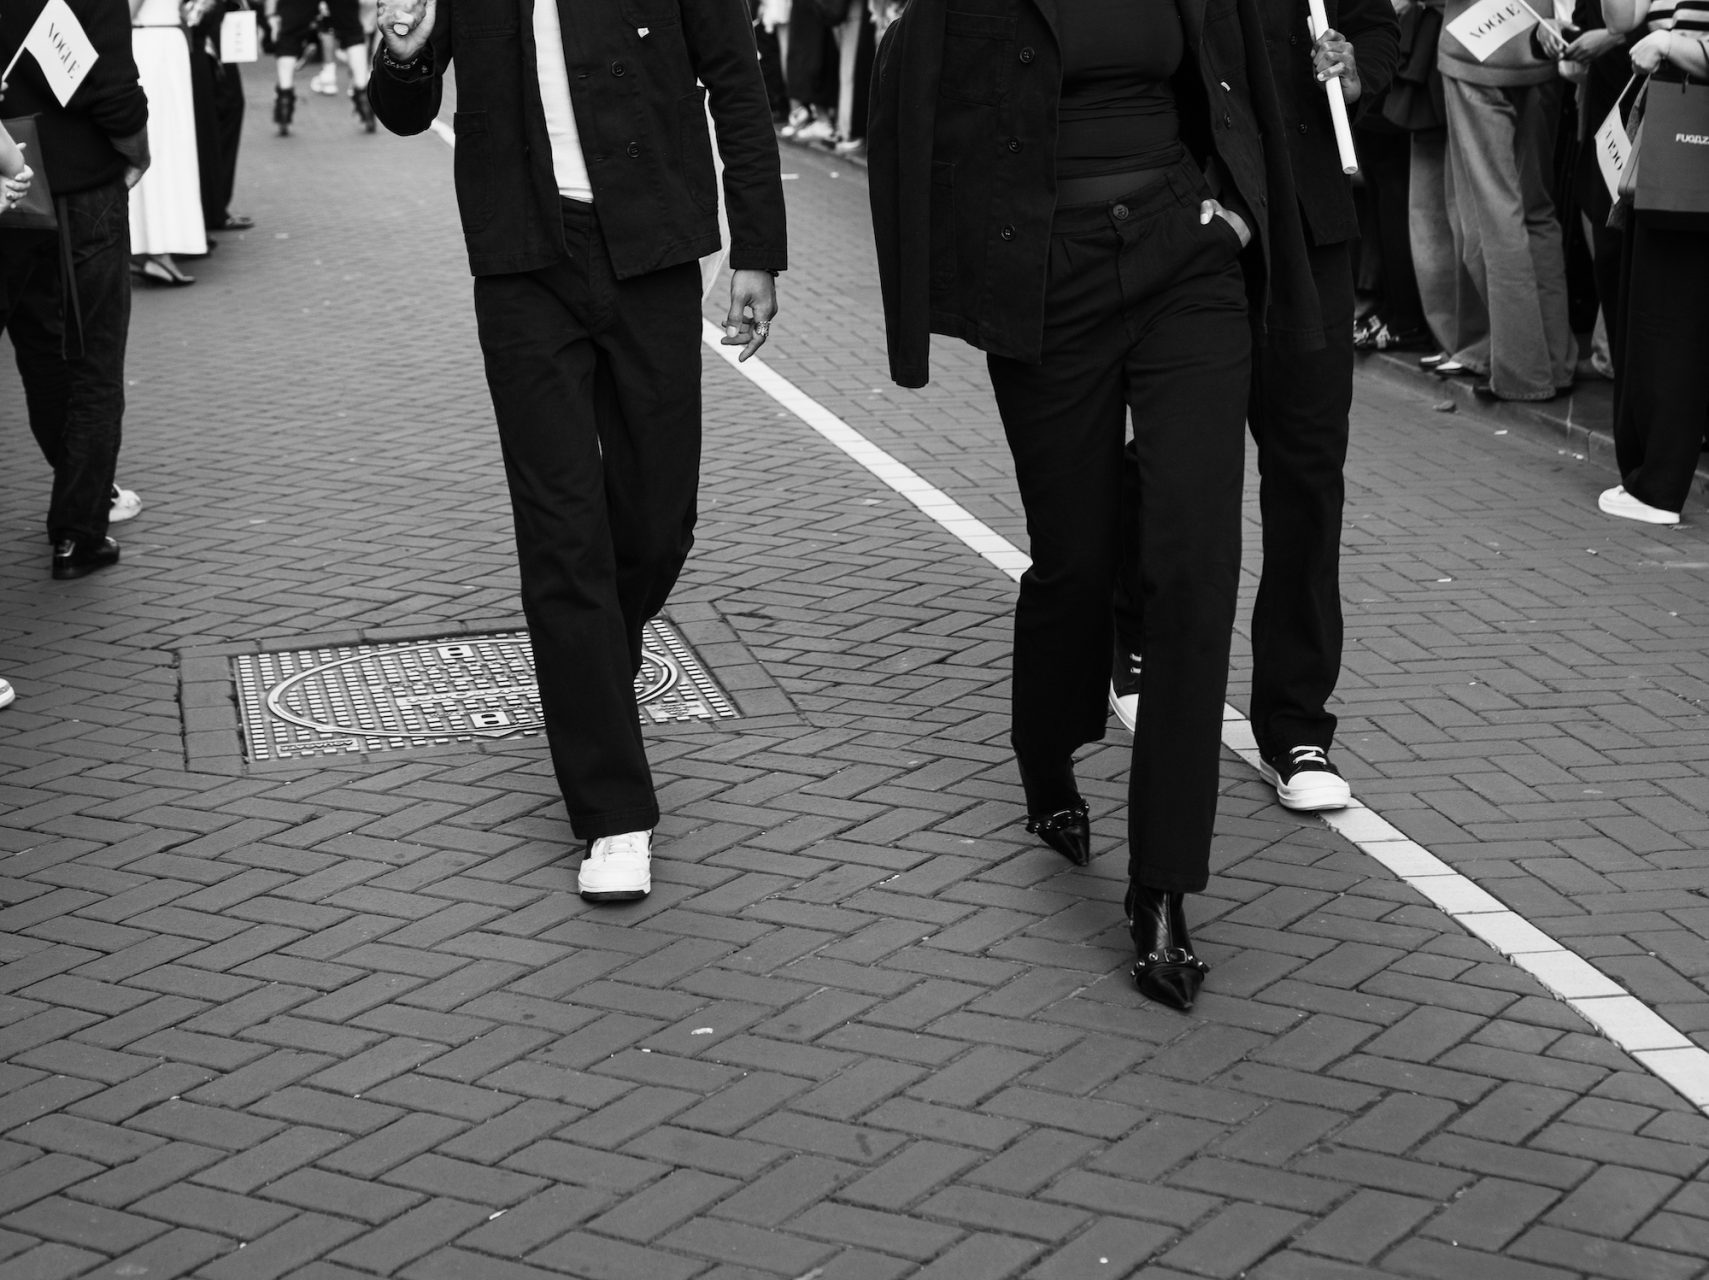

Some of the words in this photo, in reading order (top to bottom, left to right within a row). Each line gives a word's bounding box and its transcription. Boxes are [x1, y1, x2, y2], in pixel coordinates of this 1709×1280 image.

[1469, 3, 1521, 39] VOGUE
[48, 22, 80, 80] VOGUE
[1675, 133, 1709, 145] FUGAZ
